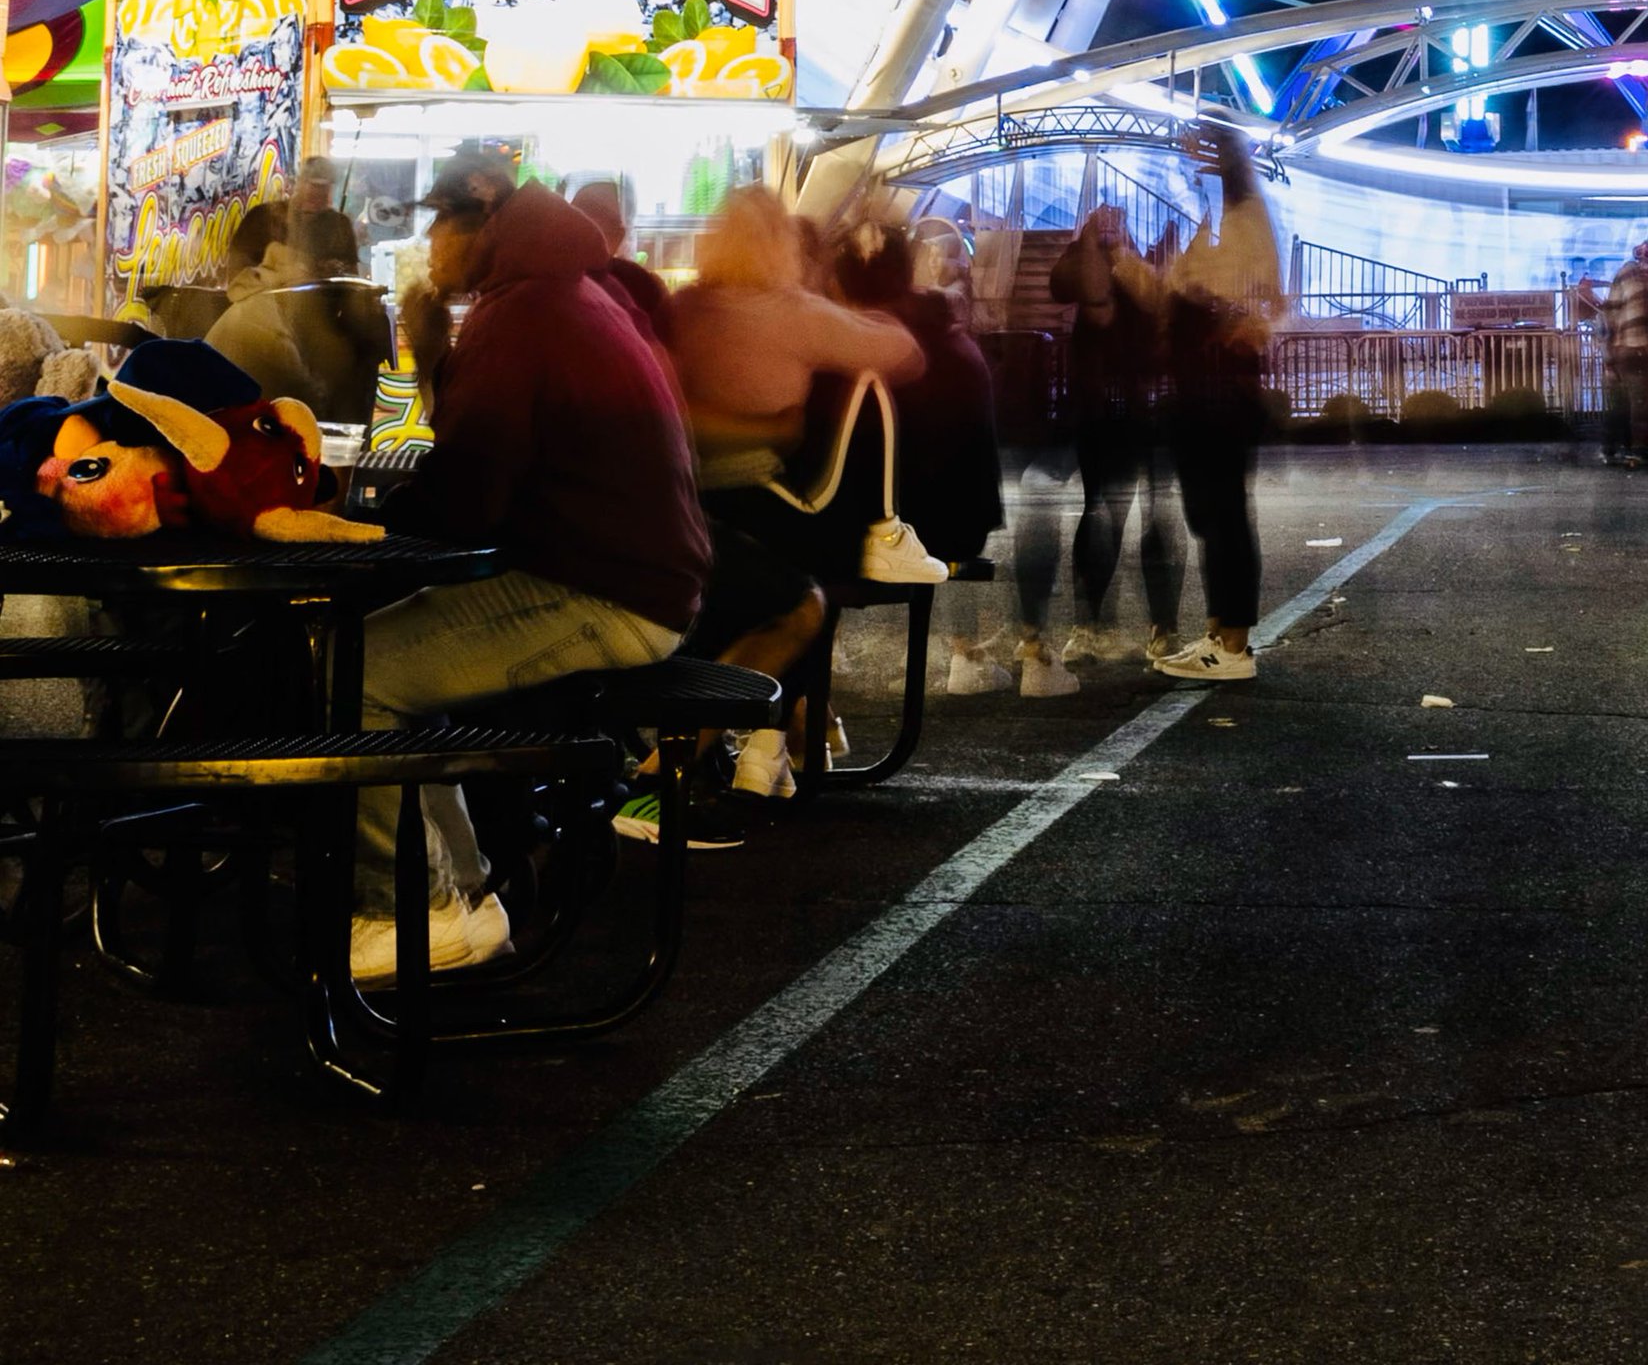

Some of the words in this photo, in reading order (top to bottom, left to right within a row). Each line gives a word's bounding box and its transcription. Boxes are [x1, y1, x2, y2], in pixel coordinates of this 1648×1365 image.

[199, 60, 285, 103] Refreshing
[131, 150, 168, 190] FRESH
[174, 119, 230, 169] SQUEEZED
